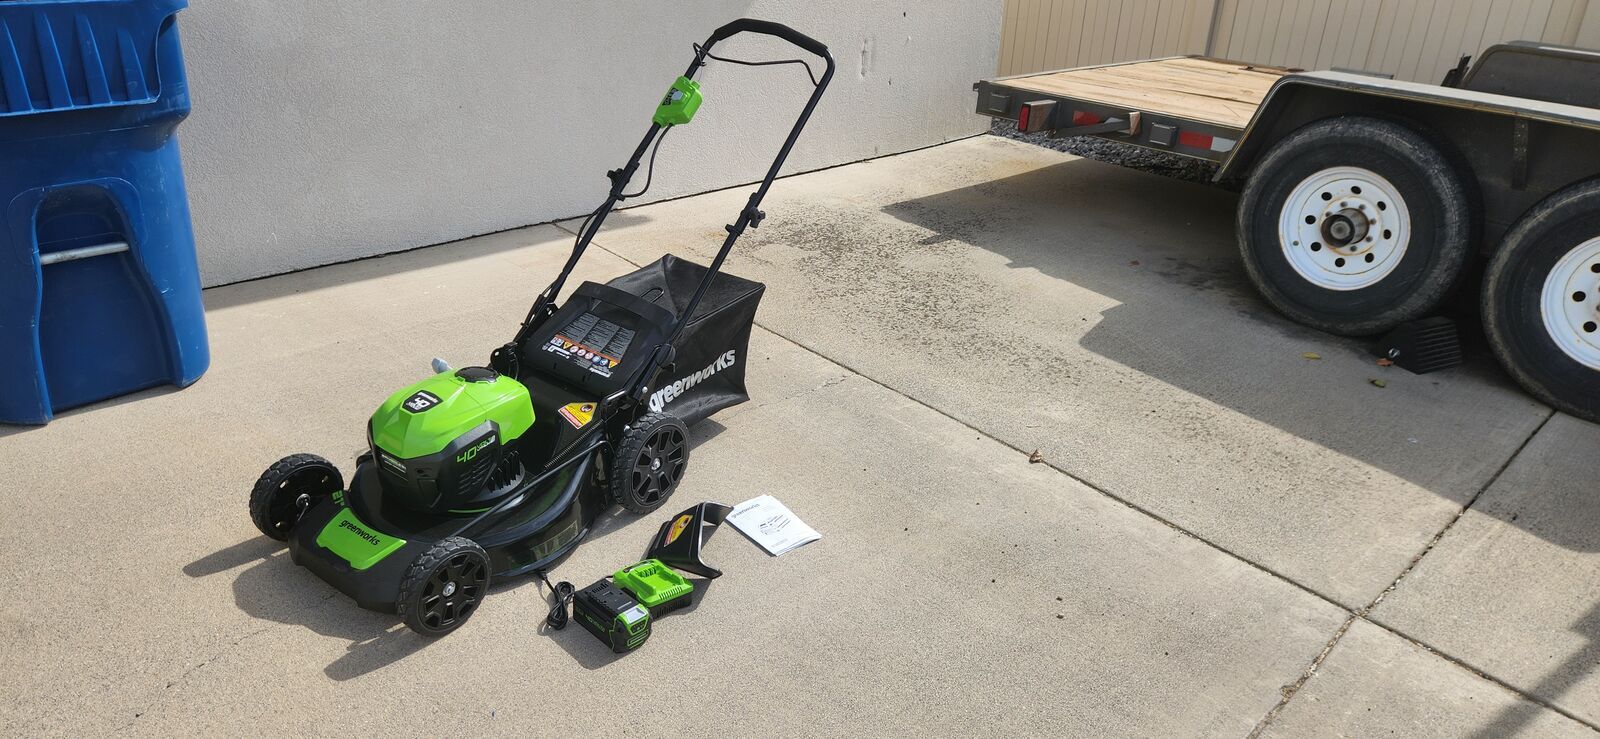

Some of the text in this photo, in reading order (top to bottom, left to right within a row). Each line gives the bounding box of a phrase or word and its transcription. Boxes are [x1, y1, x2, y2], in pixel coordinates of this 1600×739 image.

[649, 349, 735, 413] greenworks
[457, 446, 477, 462] 40
[339, 520, 380, 545] greenworks
